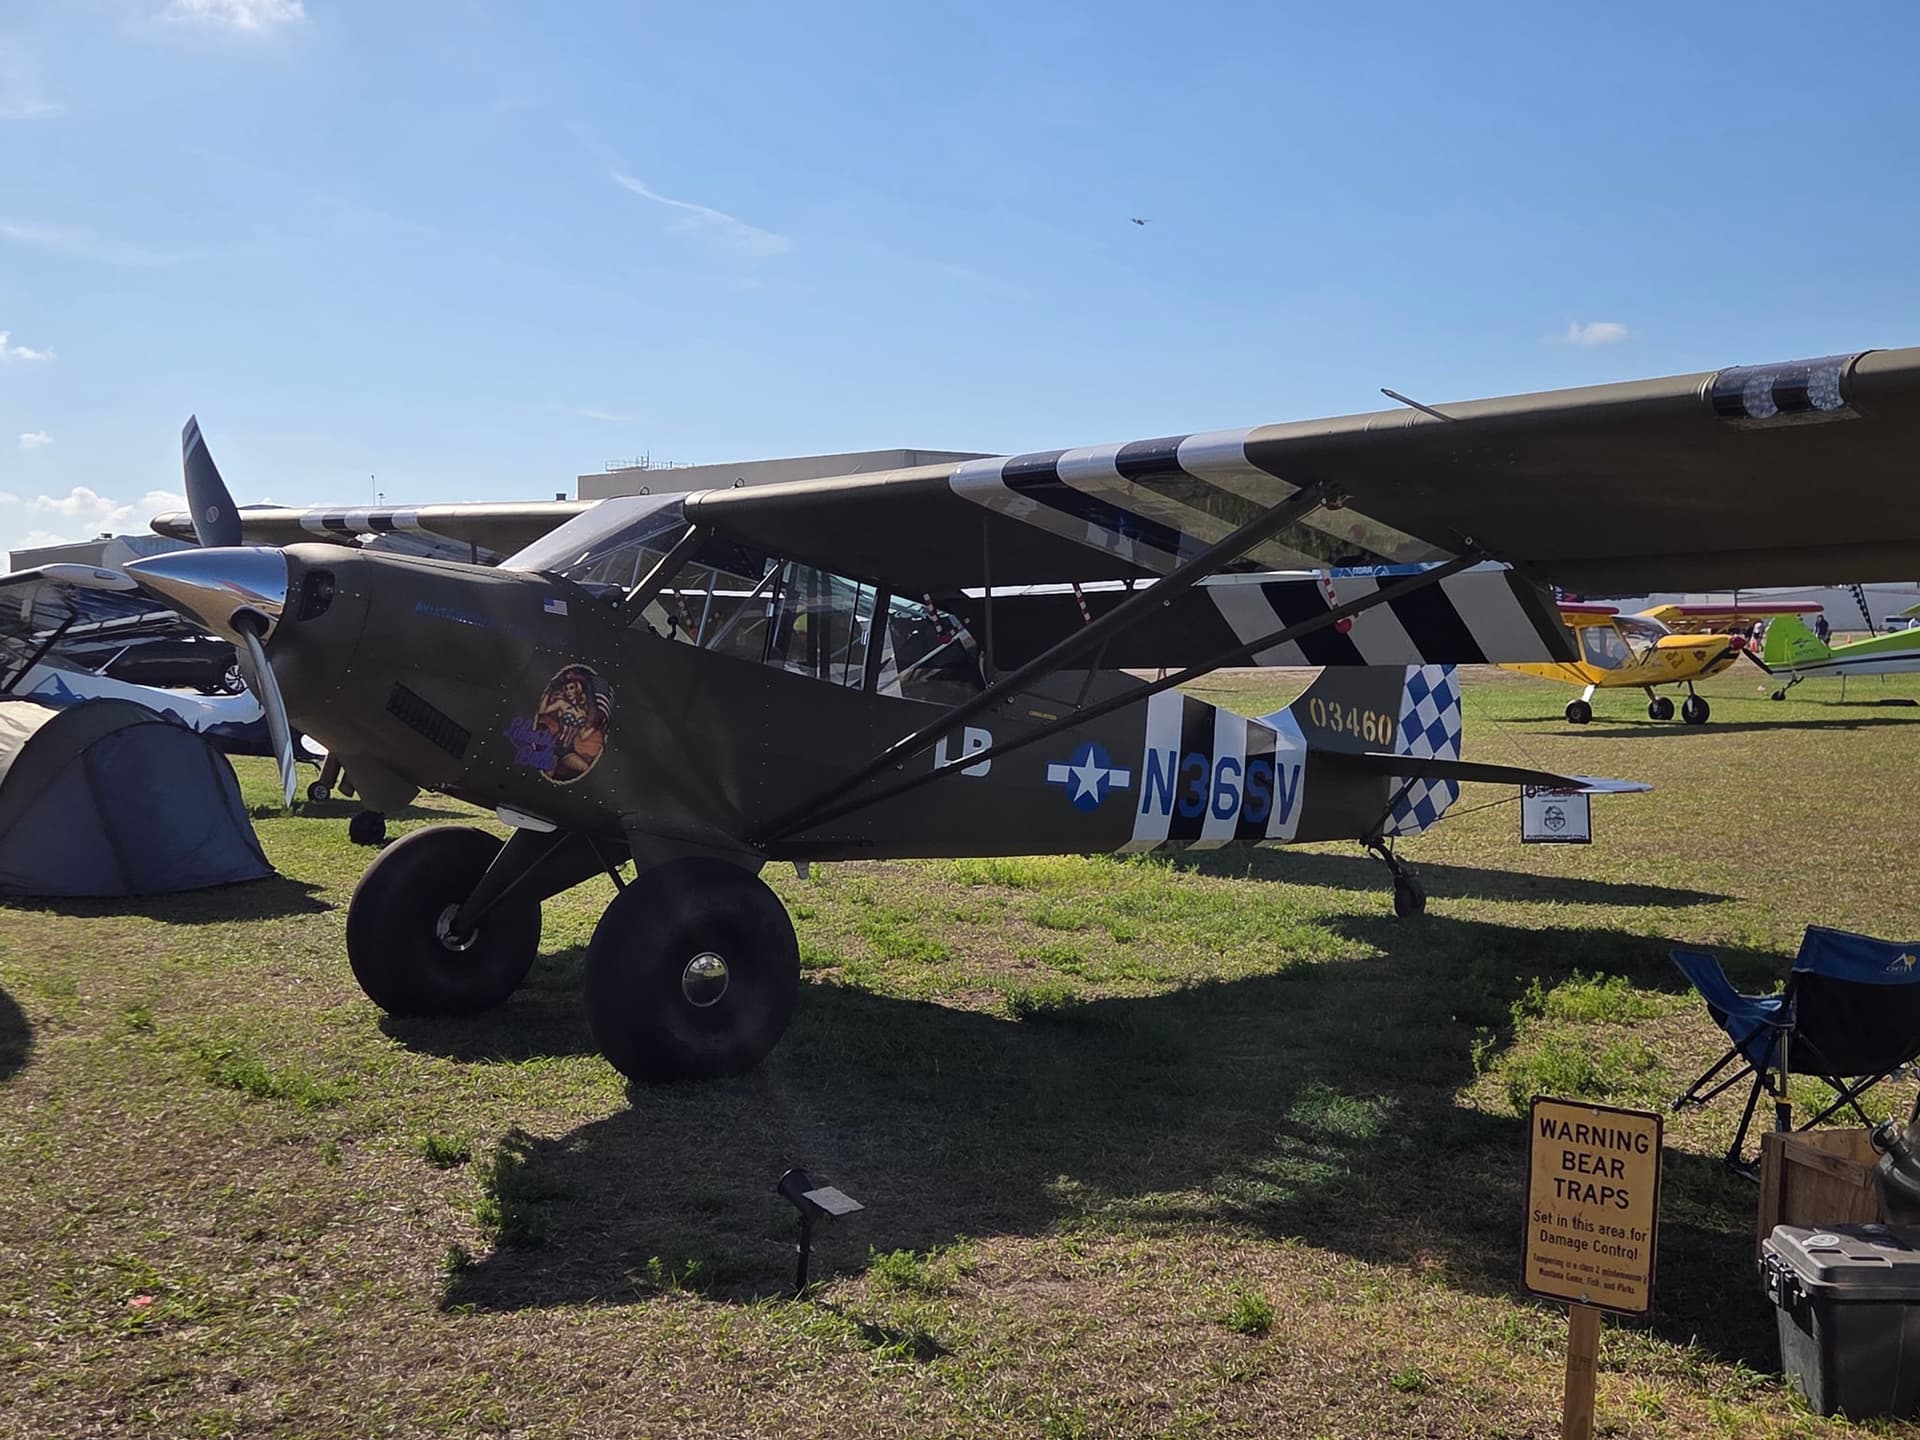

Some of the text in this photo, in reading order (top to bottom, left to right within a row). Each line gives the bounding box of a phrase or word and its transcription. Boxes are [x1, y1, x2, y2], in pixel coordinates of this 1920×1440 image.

[1309, 697, 1393, 746] 03460
[1141, 747, 1301, 826] N36SV
[1540, 1118, 1650, 1154] WARNING
[1562, 1151, 1625, 1180] BEAR
[1554, 1178, 1630, 1210] TRAPS
[1533, 1210, 1647, 1243] Set in this area for
[1540, 1230, 1638, 1261] Damage Control
